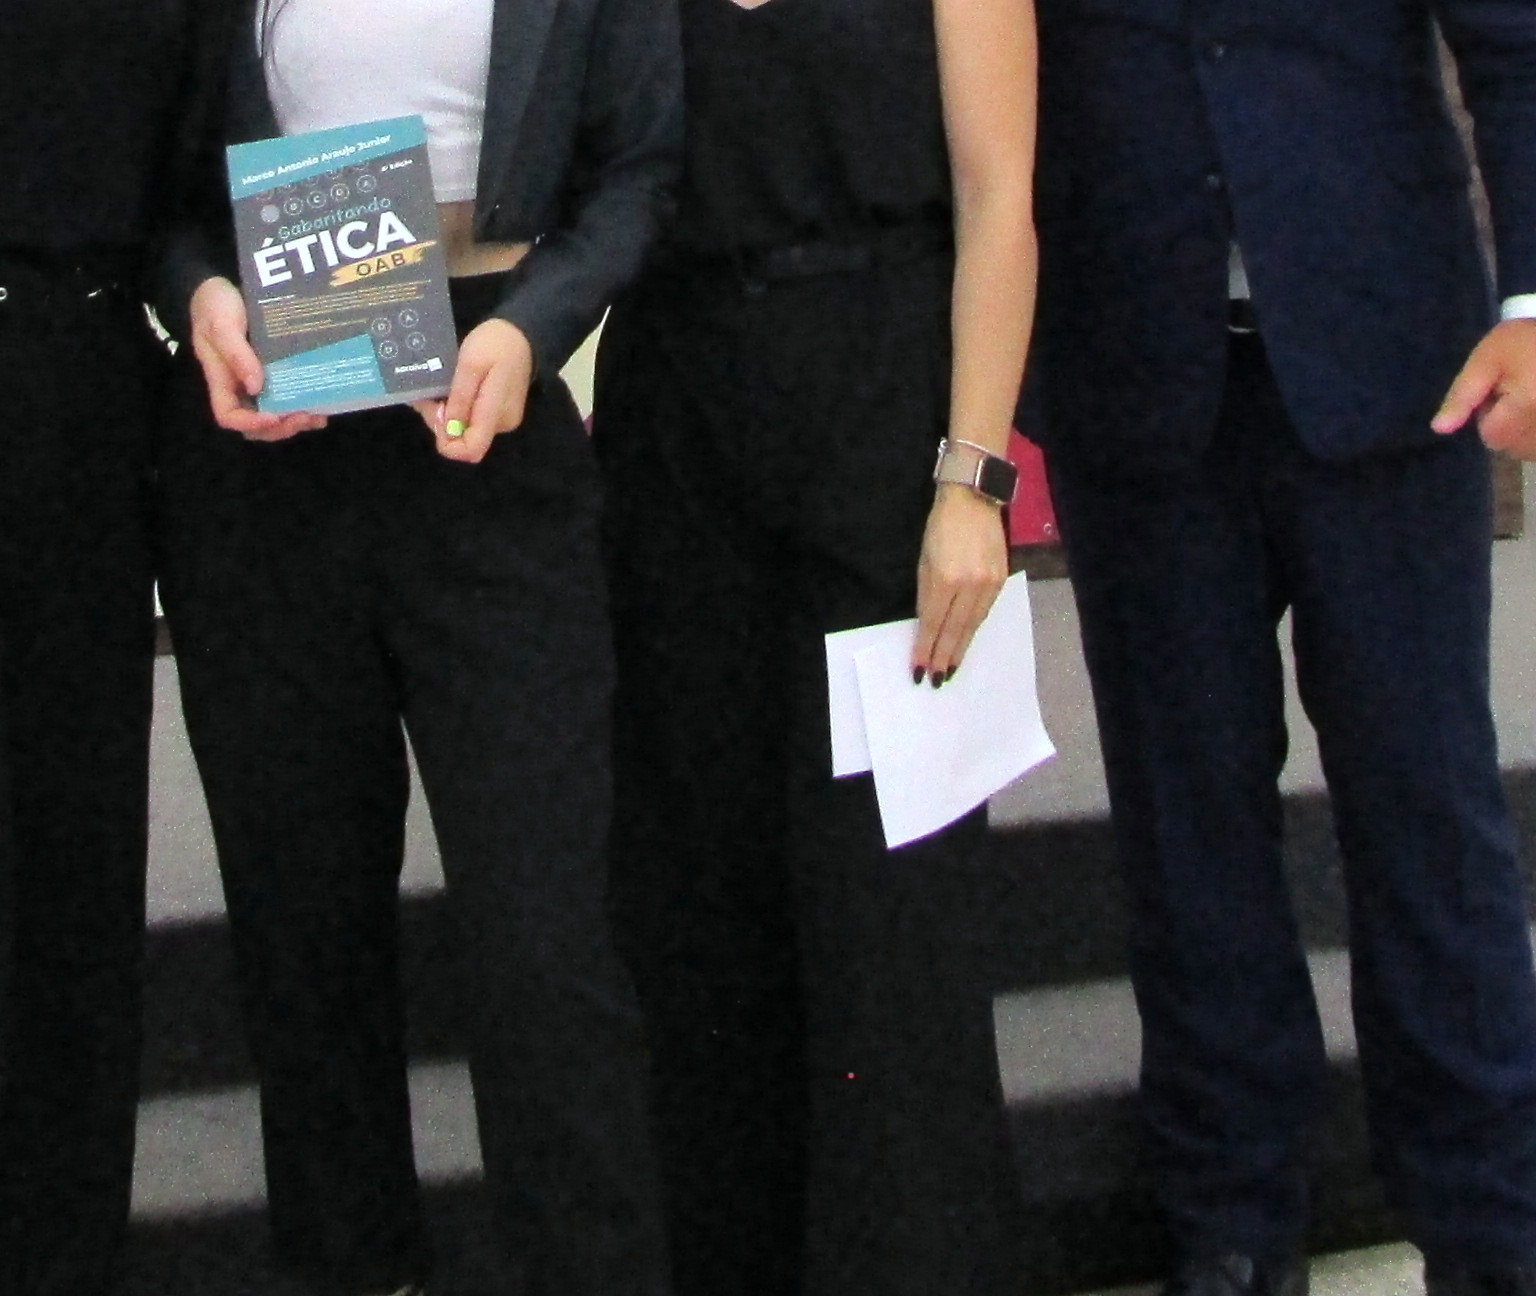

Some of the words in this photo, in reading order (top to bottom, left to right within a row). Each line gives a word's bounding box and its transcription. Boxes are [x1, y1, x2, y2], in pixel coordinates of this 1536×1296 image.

[241, 171, 275, 186] Marco
[275, 156, 320, 176] Antonio
[278, 197, 392, 239] Gabaritando
[253, 211, 417, 288] ÉTICA
[355, 252, 406, 276] OAB
